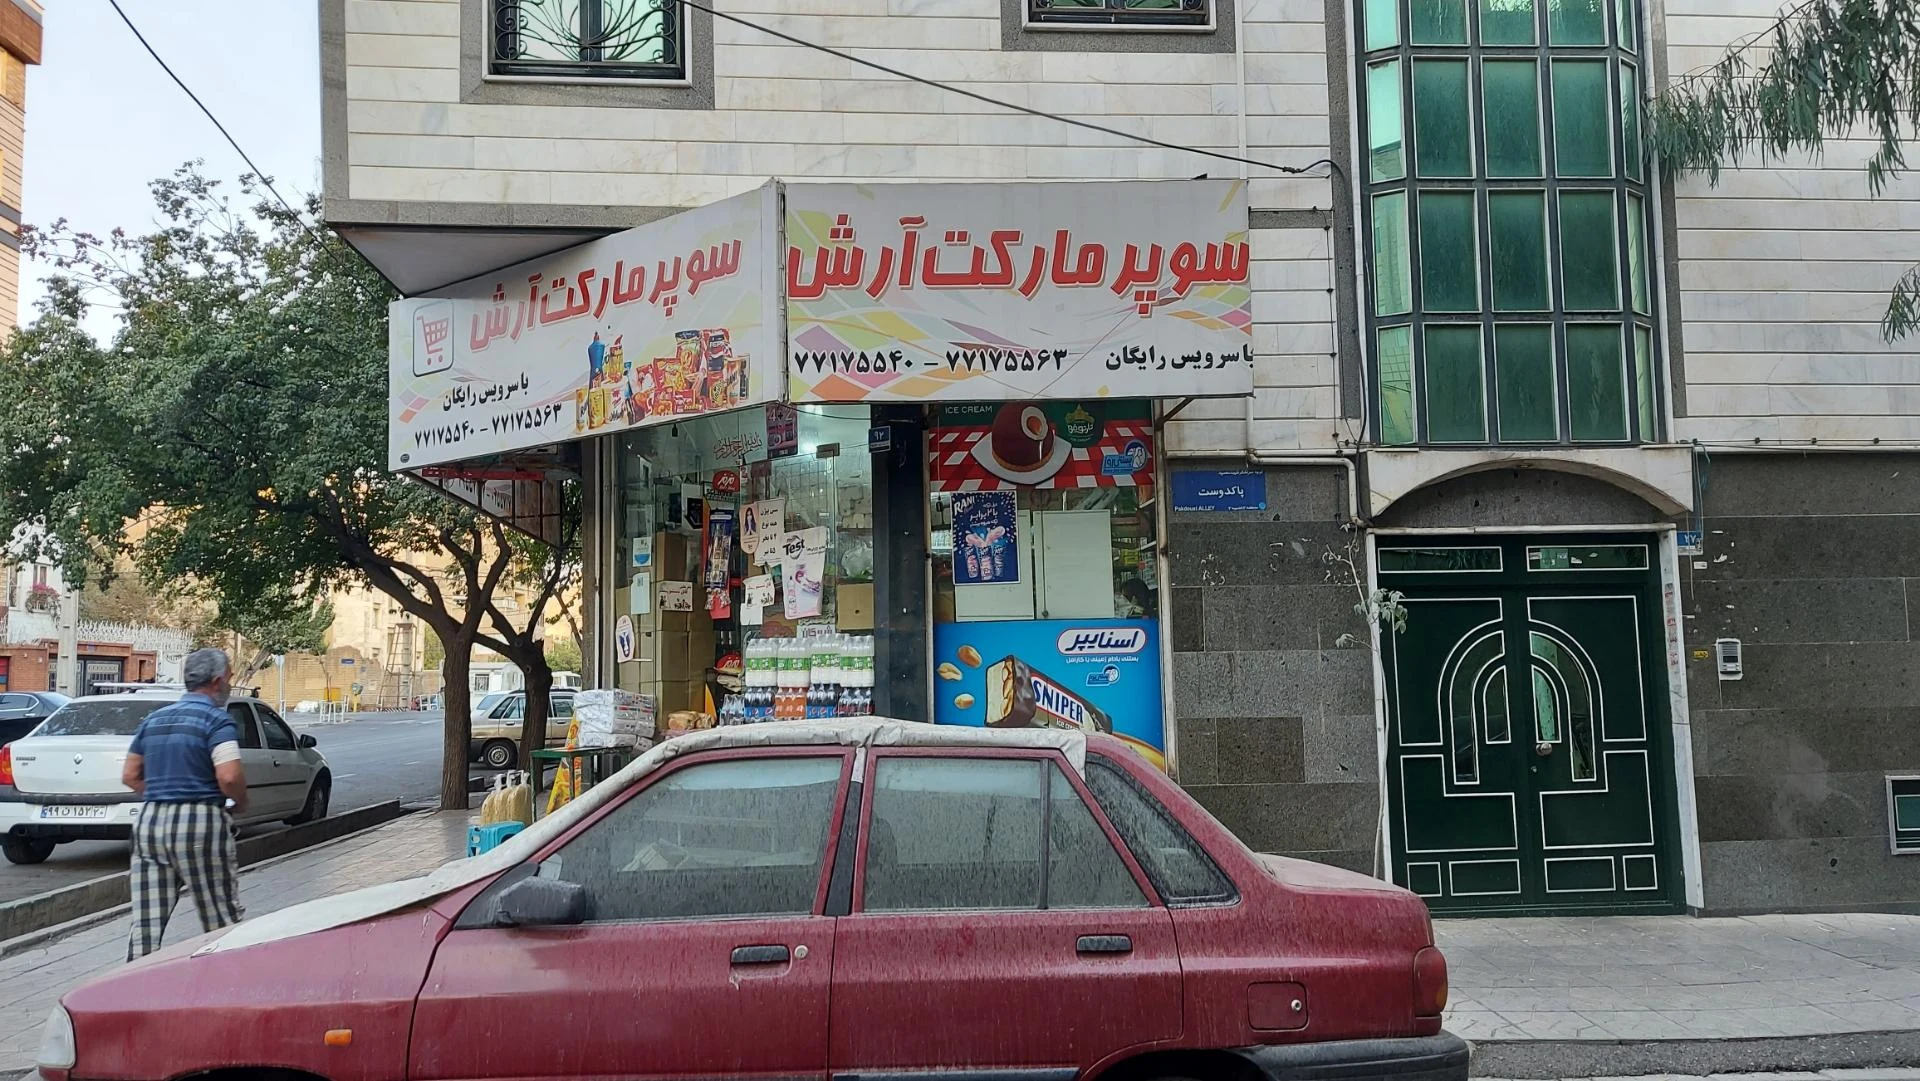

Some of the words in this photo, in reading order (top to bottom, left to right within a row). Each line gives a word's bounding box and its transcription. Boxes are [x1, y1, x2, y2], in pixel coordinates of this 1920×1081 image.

[794, 350, 913, 374] ۷۷۱۷۵۵۴۰
[946, 349, 1067, 374] ۷۷۱۷۵۵۶۳
[1106, 345, 1166, 370] رایگان
[443, 384, 476, 411] رایگان
[944, 405, 960, 414] ICE
[961, 405, 992, 414] CREAM
[415, 420, 474, 448] ۷۷۱۷۵۵۴۰
[492, 402, 562, 435] ۷۷۱۷۵۵۶۳
[1198, 485, 1244, 499] پاکدوست
[953, 495, 975, 516] RANI
[1065, 631, 1140, 652] اسنایپر
[1033, 679, 1084, 723] SNIPER
